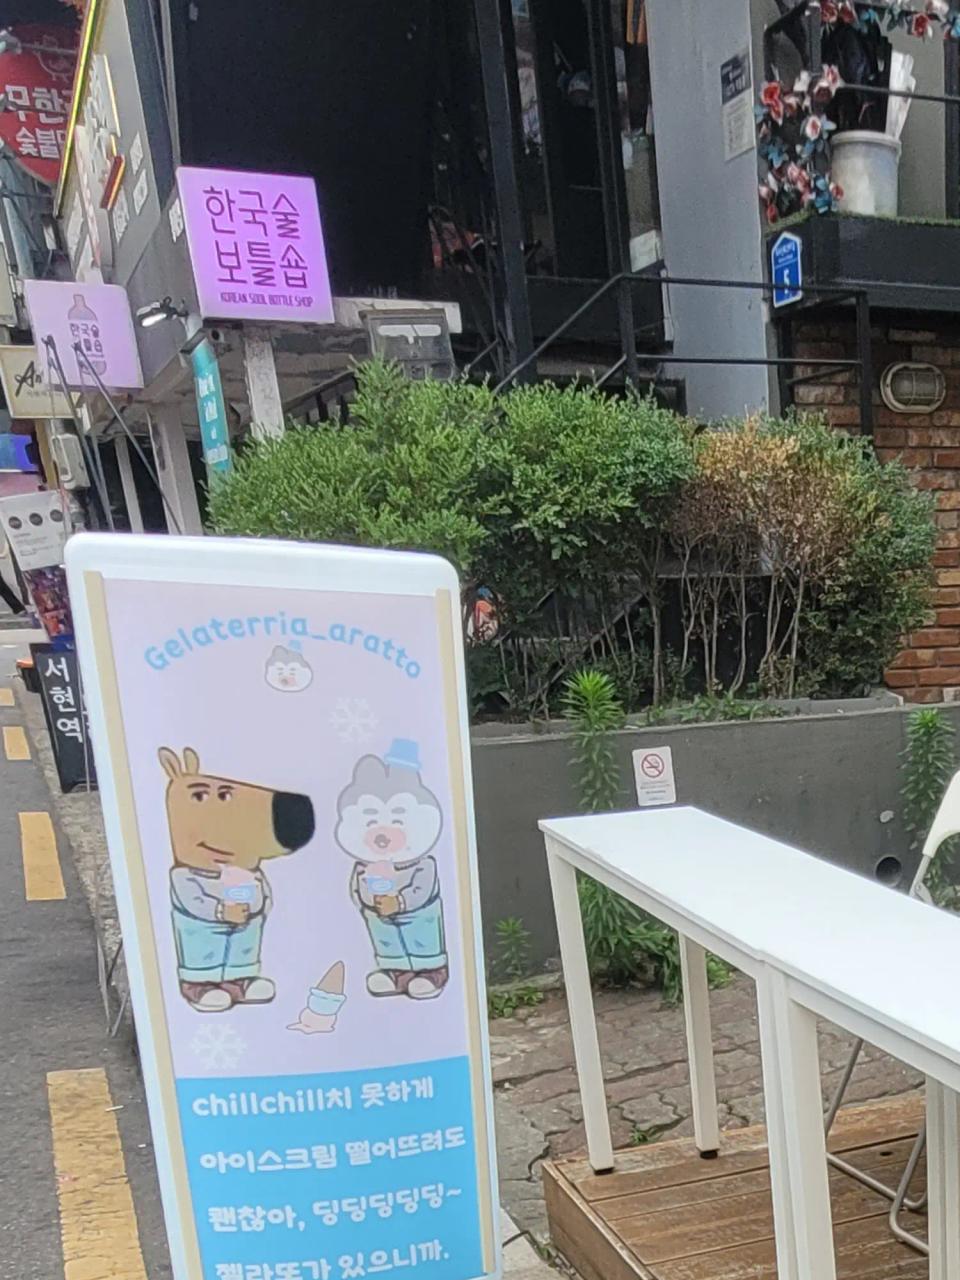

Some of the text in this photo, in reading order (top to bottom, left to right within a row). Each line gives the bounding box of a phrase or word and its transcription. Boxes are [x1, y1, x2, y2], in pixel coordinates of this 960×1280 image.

[203, 186, 301, 240] 한국술
[214, 240, 308, 289] 보틀숍
[294, 295, 313, 308] SHOP
[144, 611, 421, 679] Gelaterria_aratto
[192, 1075, 434, 1117] chillchill치 못하게
[200, 1126, 466, 1174] 아이스크림 떨어뜨려도
[312, 1182, 462, 1226] 딩딩딩딩딩~
[338, 1238, 450, 1280] 있으니까.
